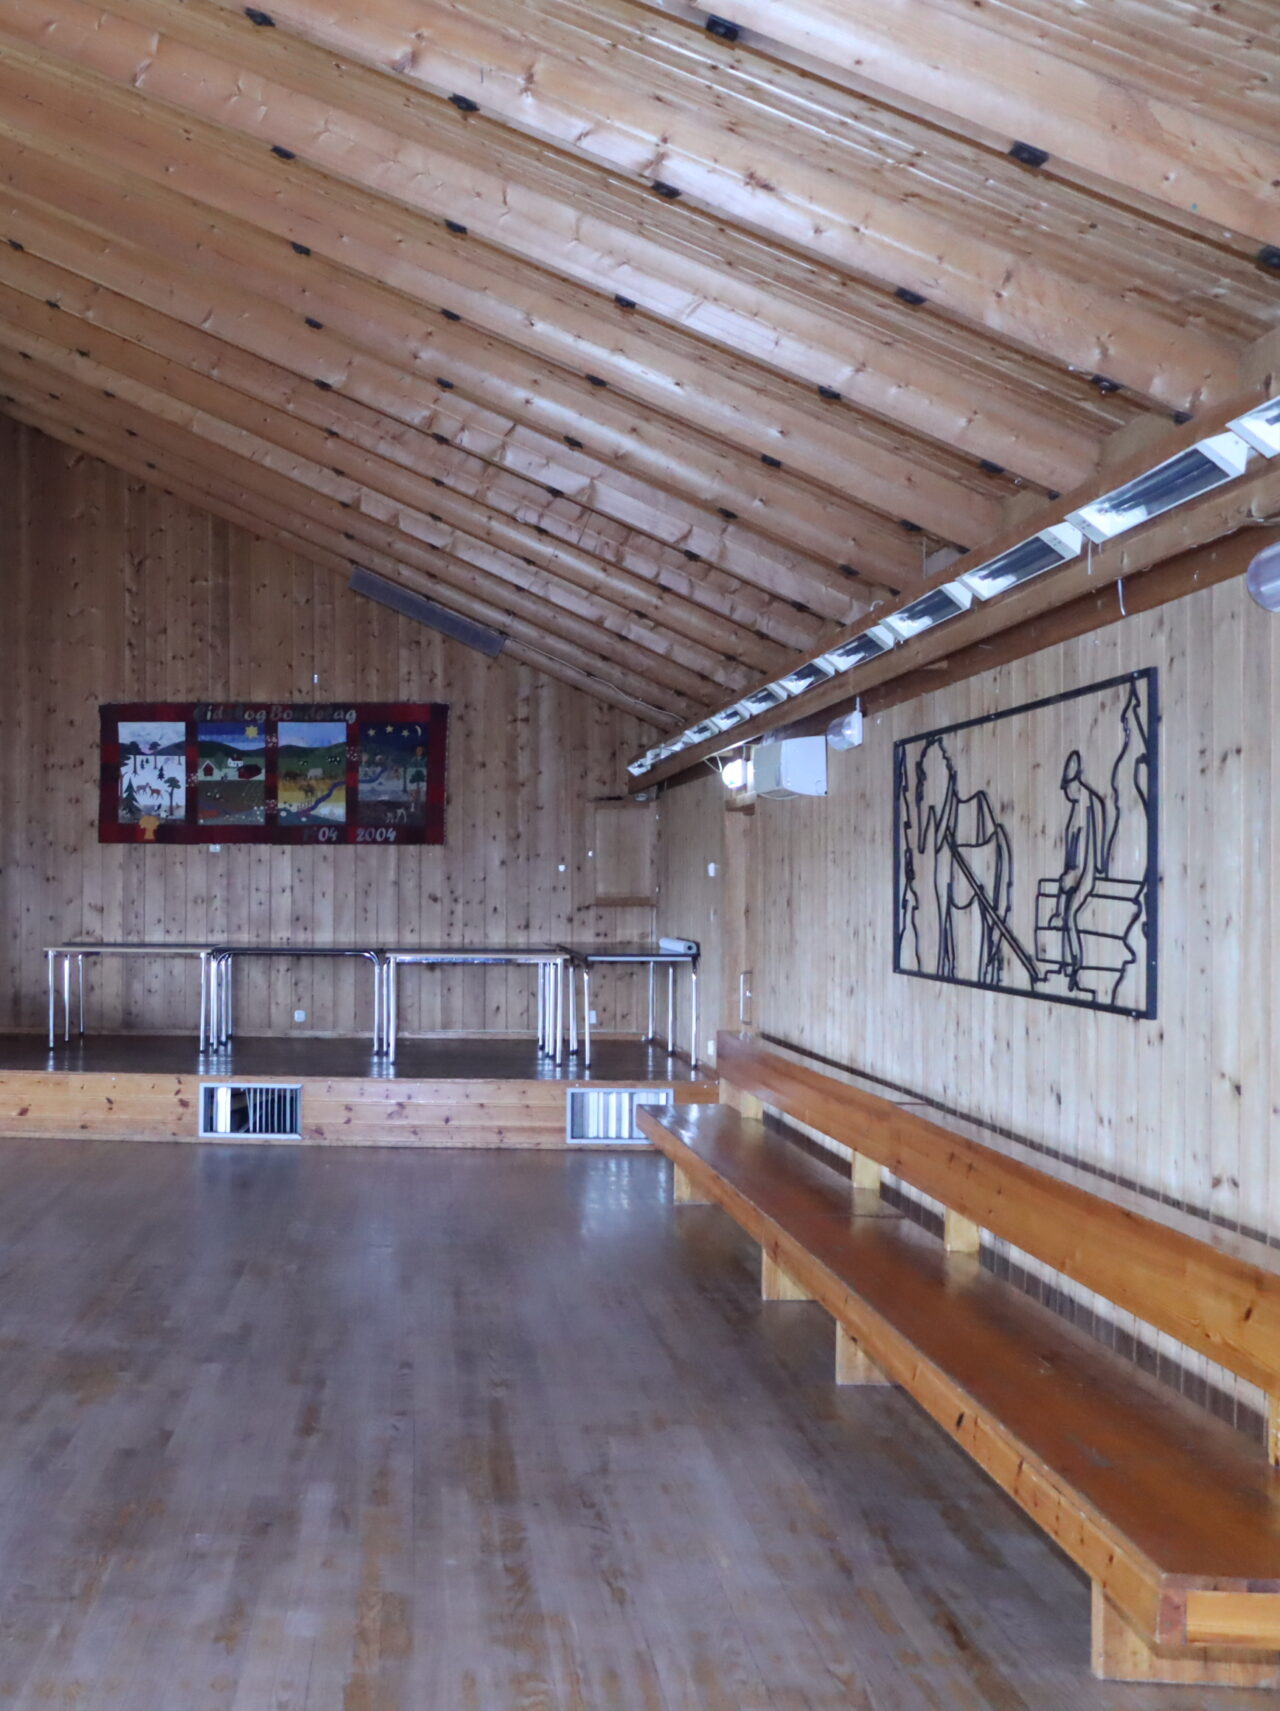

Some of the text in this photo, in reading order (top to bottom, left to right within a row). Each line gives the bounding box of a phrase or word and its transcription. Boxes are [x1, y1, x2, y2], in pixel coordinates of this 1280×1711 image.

[193, 704, 358, 725] idog Bodeag
[356, 827, 397, 842] 2004
